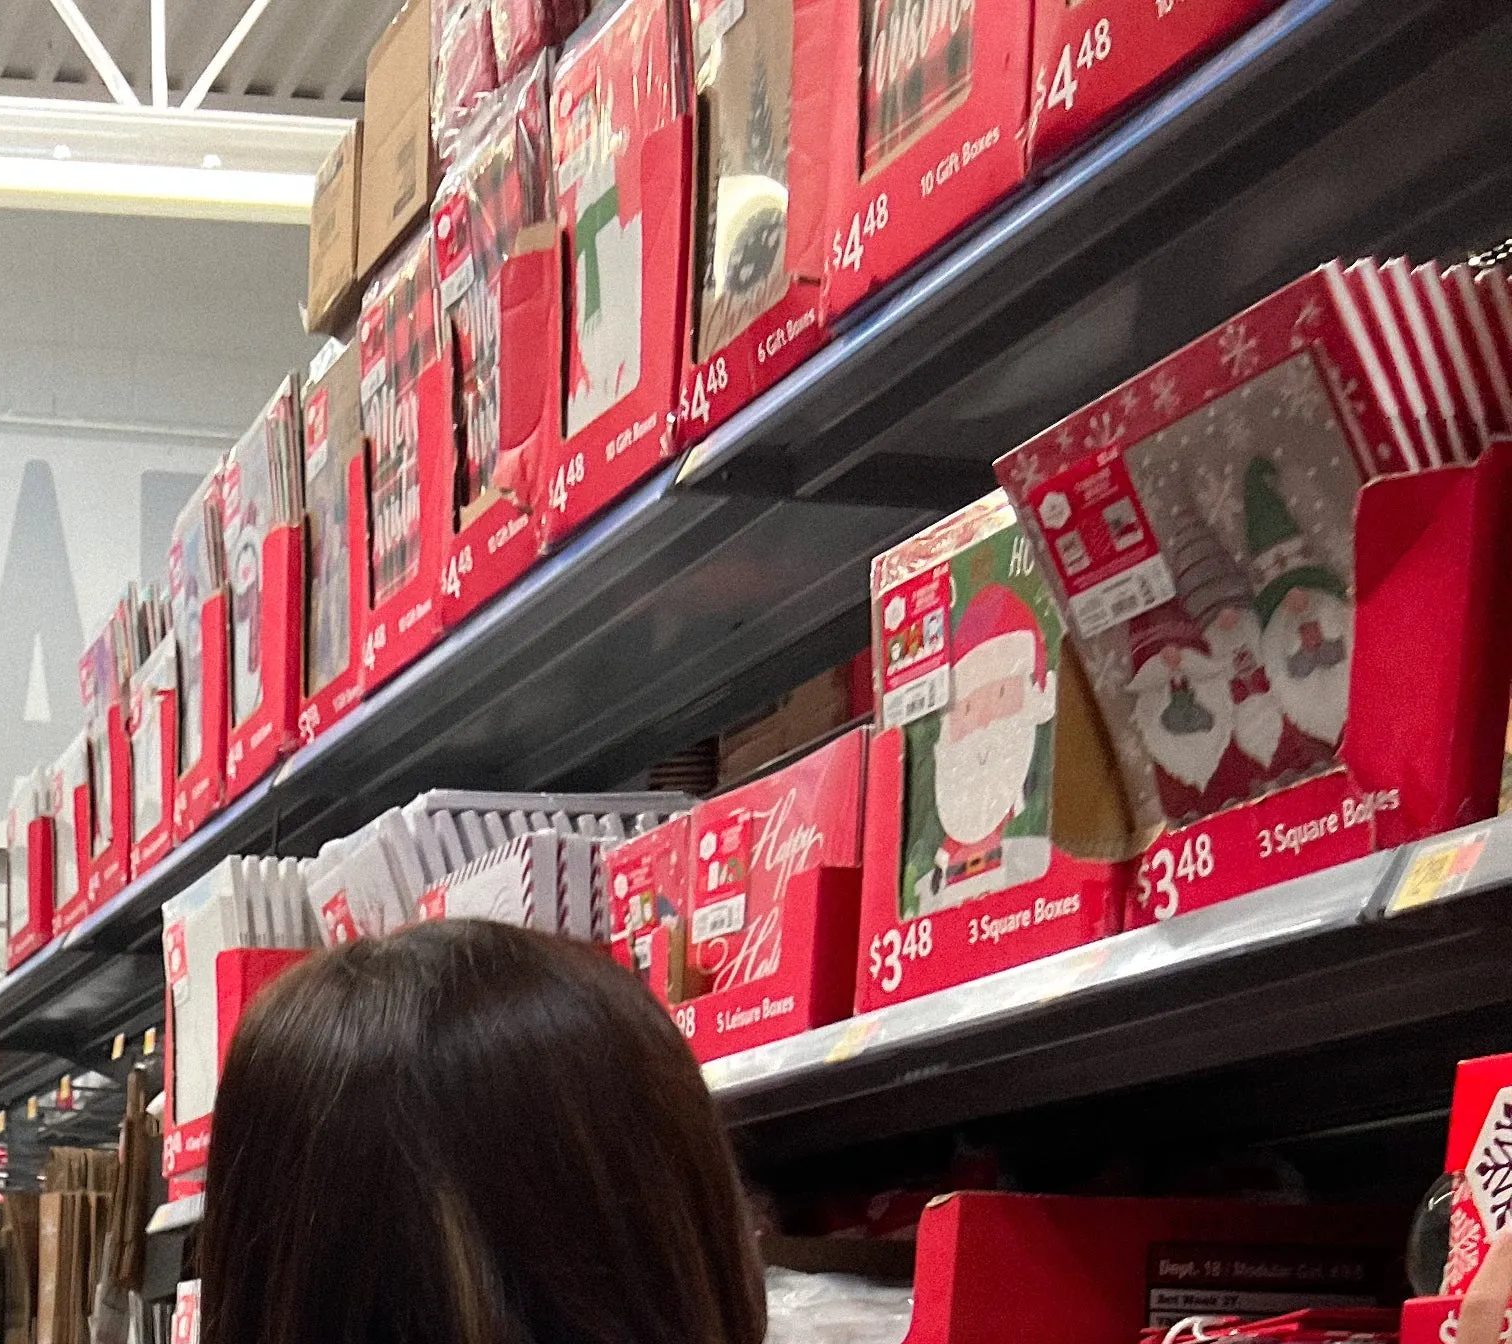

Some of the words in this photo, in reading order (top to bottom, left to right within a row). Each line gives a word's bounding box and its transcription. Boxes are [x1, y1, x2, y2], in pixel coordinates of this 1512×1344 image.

[920, 169, 934, 198] 10
[935, 152, 960, 185] Gift
[961, 125, 1000, 167] Boxes
[1256, 829, 1272, 859] 3
[1273, 812, 1339, 855] Square
[1341, 787, 1400, 830] Boxes
[968, 917, 979, 945] 3
[980, 908, 1031, 944] Square
[1034, 892, 1080, 924] Boxes
[725, 1006, 761, 1031] Leisure
[762, 996, 795, 1019] Boxes
